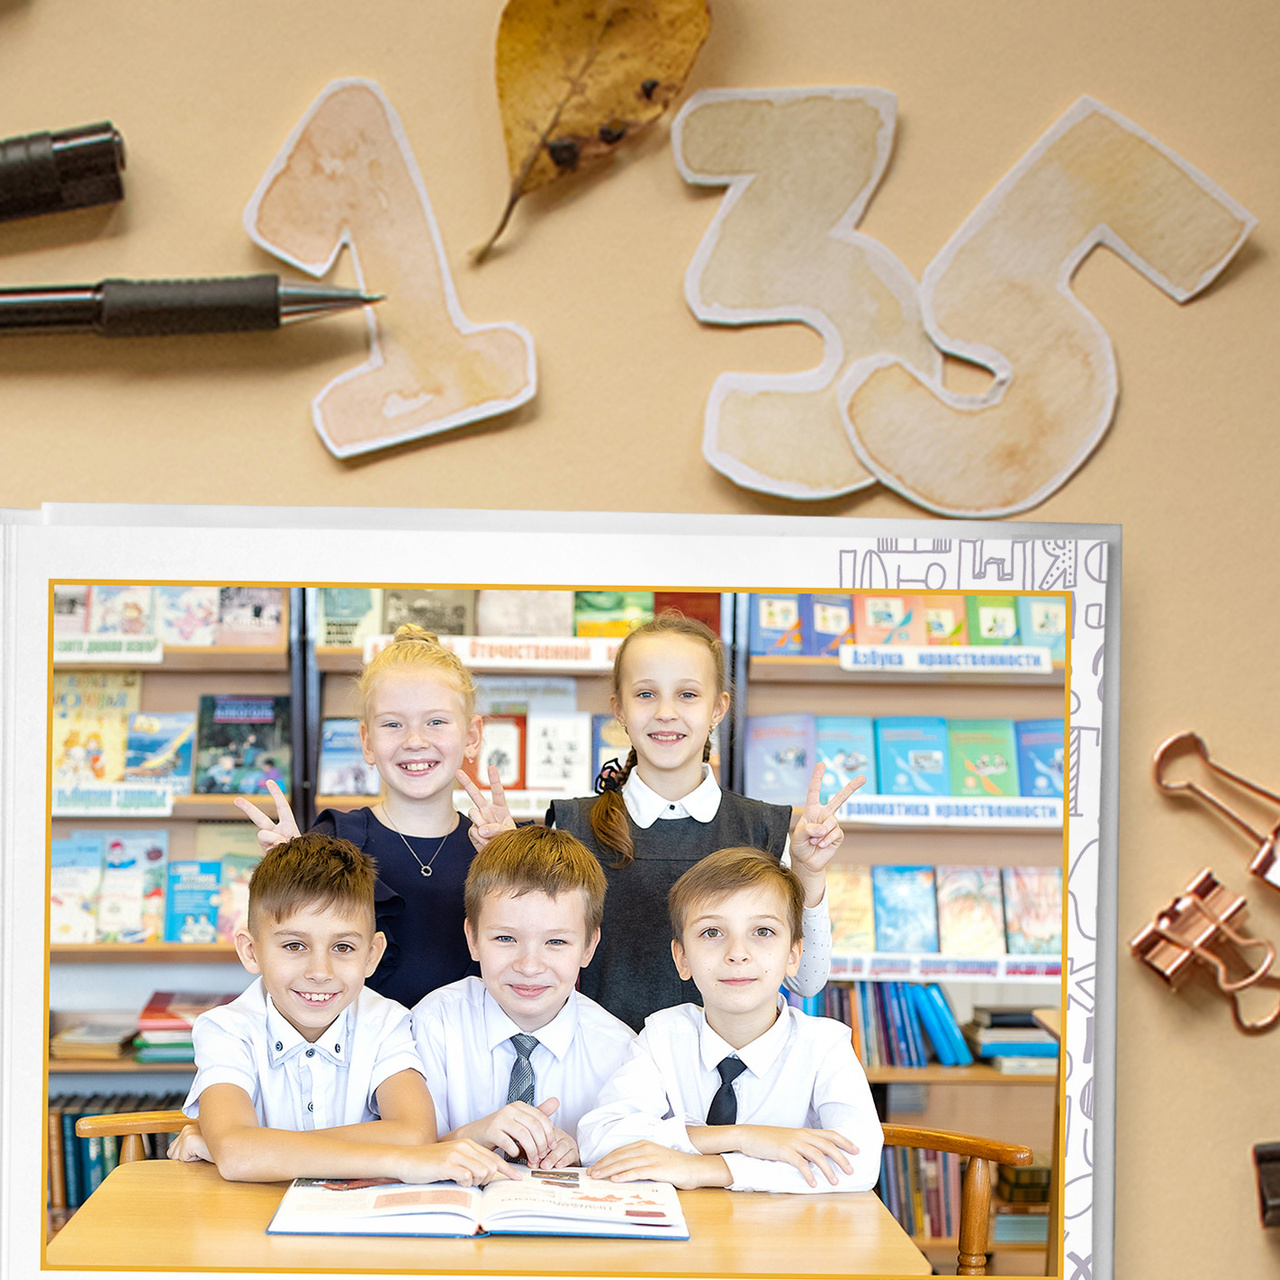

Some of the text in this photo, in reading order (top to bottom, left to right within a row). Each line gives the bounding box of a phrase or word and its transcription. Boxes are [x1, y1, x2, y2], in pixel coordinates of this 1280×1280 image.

[852, 649, 1043, 668] Азбука нравственности
[936, 804, 1057, 818] нравственности
